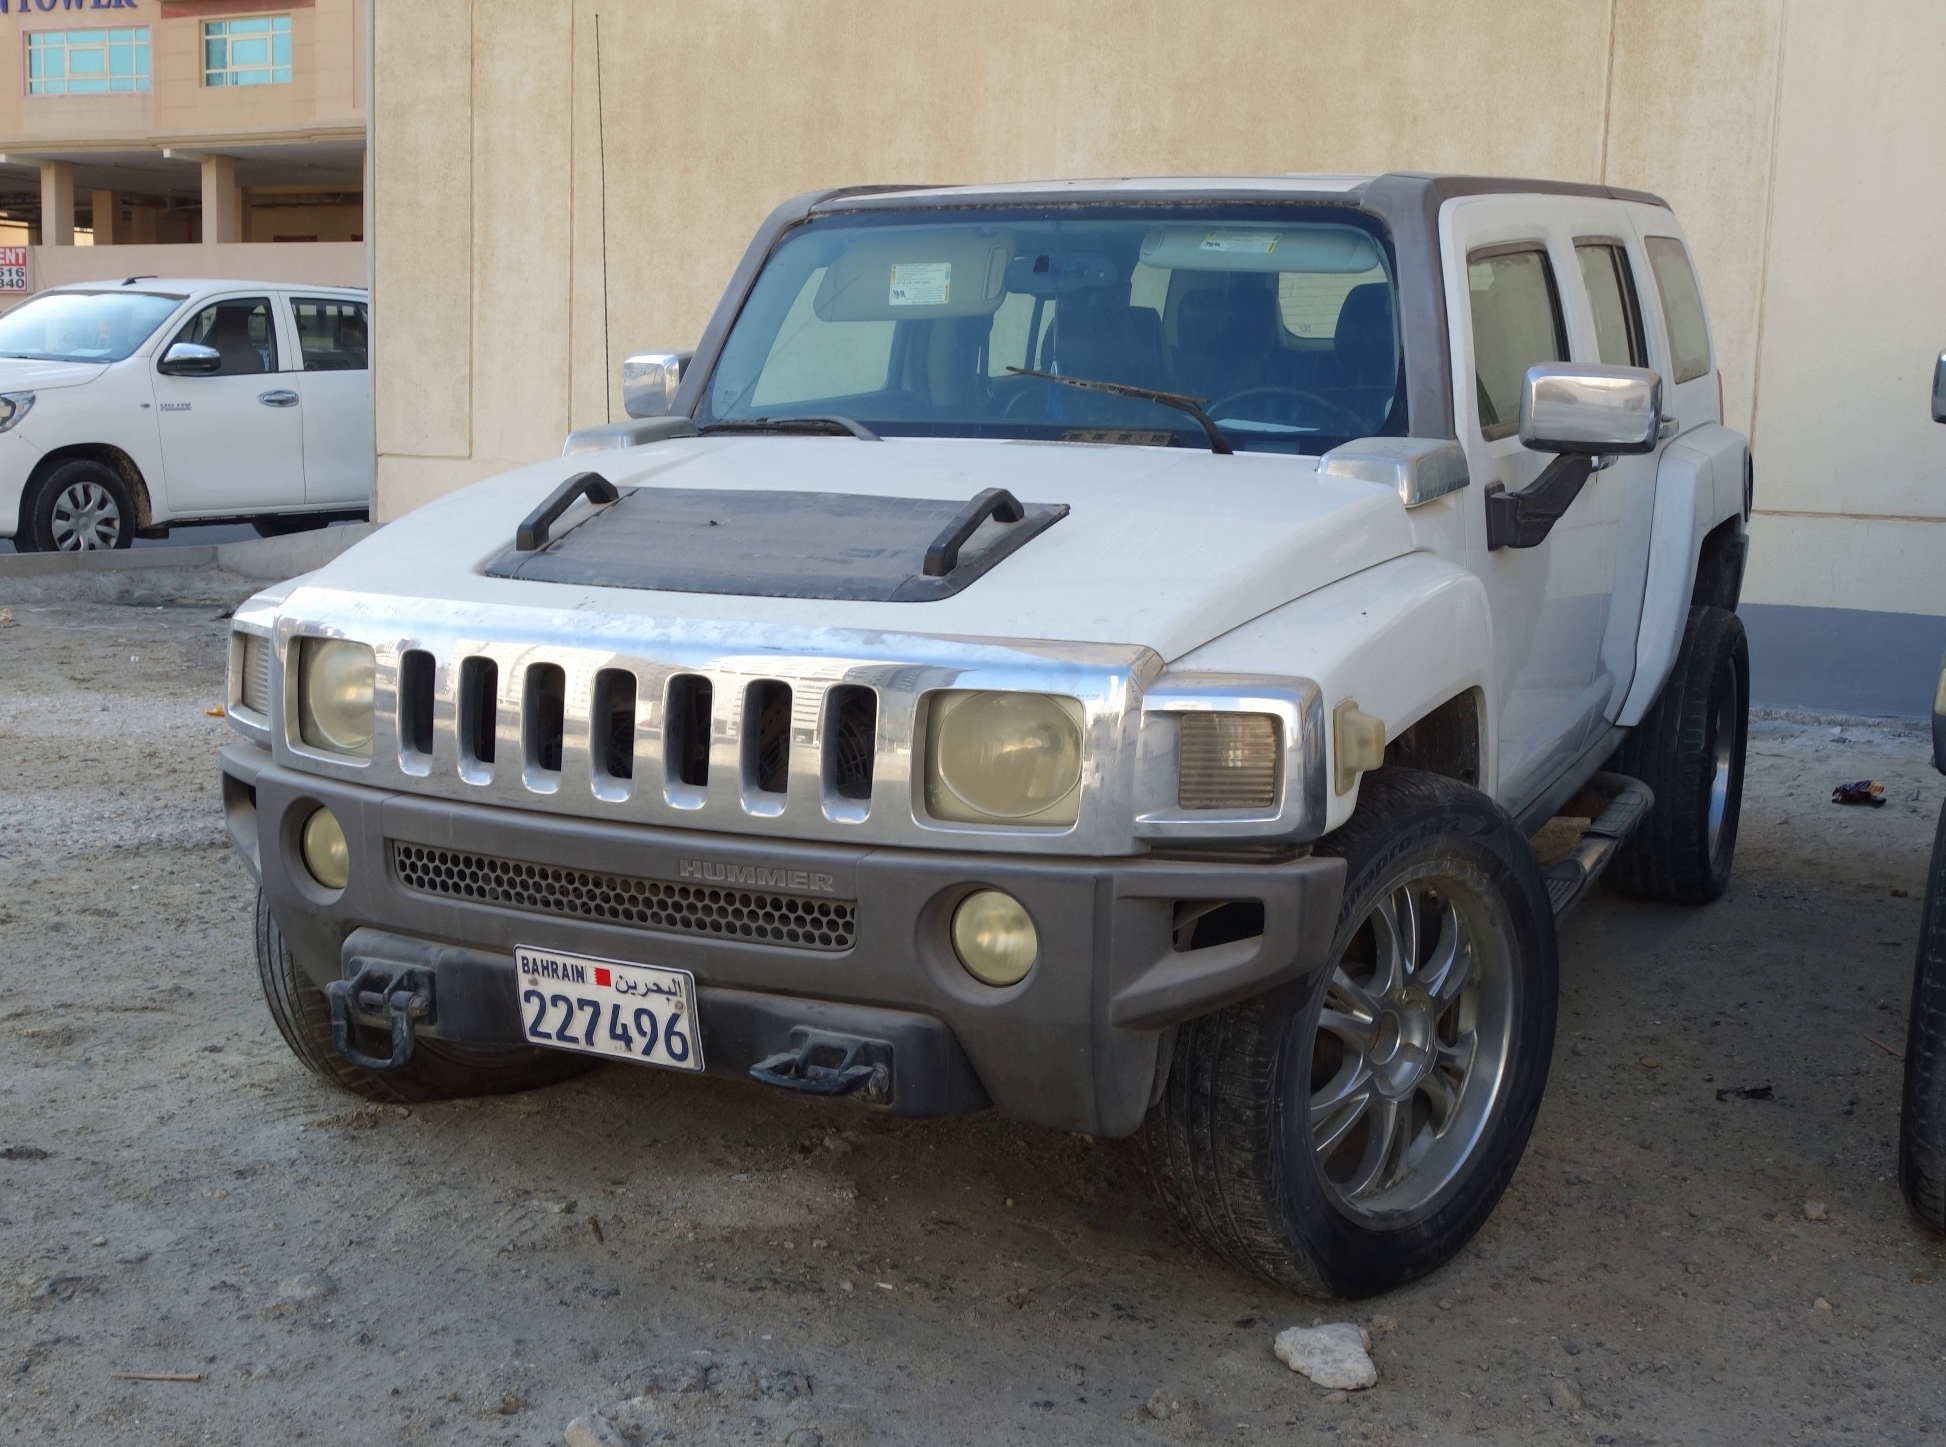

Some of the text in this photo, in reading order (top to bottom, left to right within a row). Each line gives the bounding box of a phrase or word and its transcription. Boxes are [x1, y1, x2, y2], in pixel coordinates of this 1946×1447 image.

[678, 858, 834, 892] HUMMER
[521, 956, 586, 984] BAHRAIN
[615, 974, 682, 1003] البحرين
[523, 989, 689, 1062] 227496
